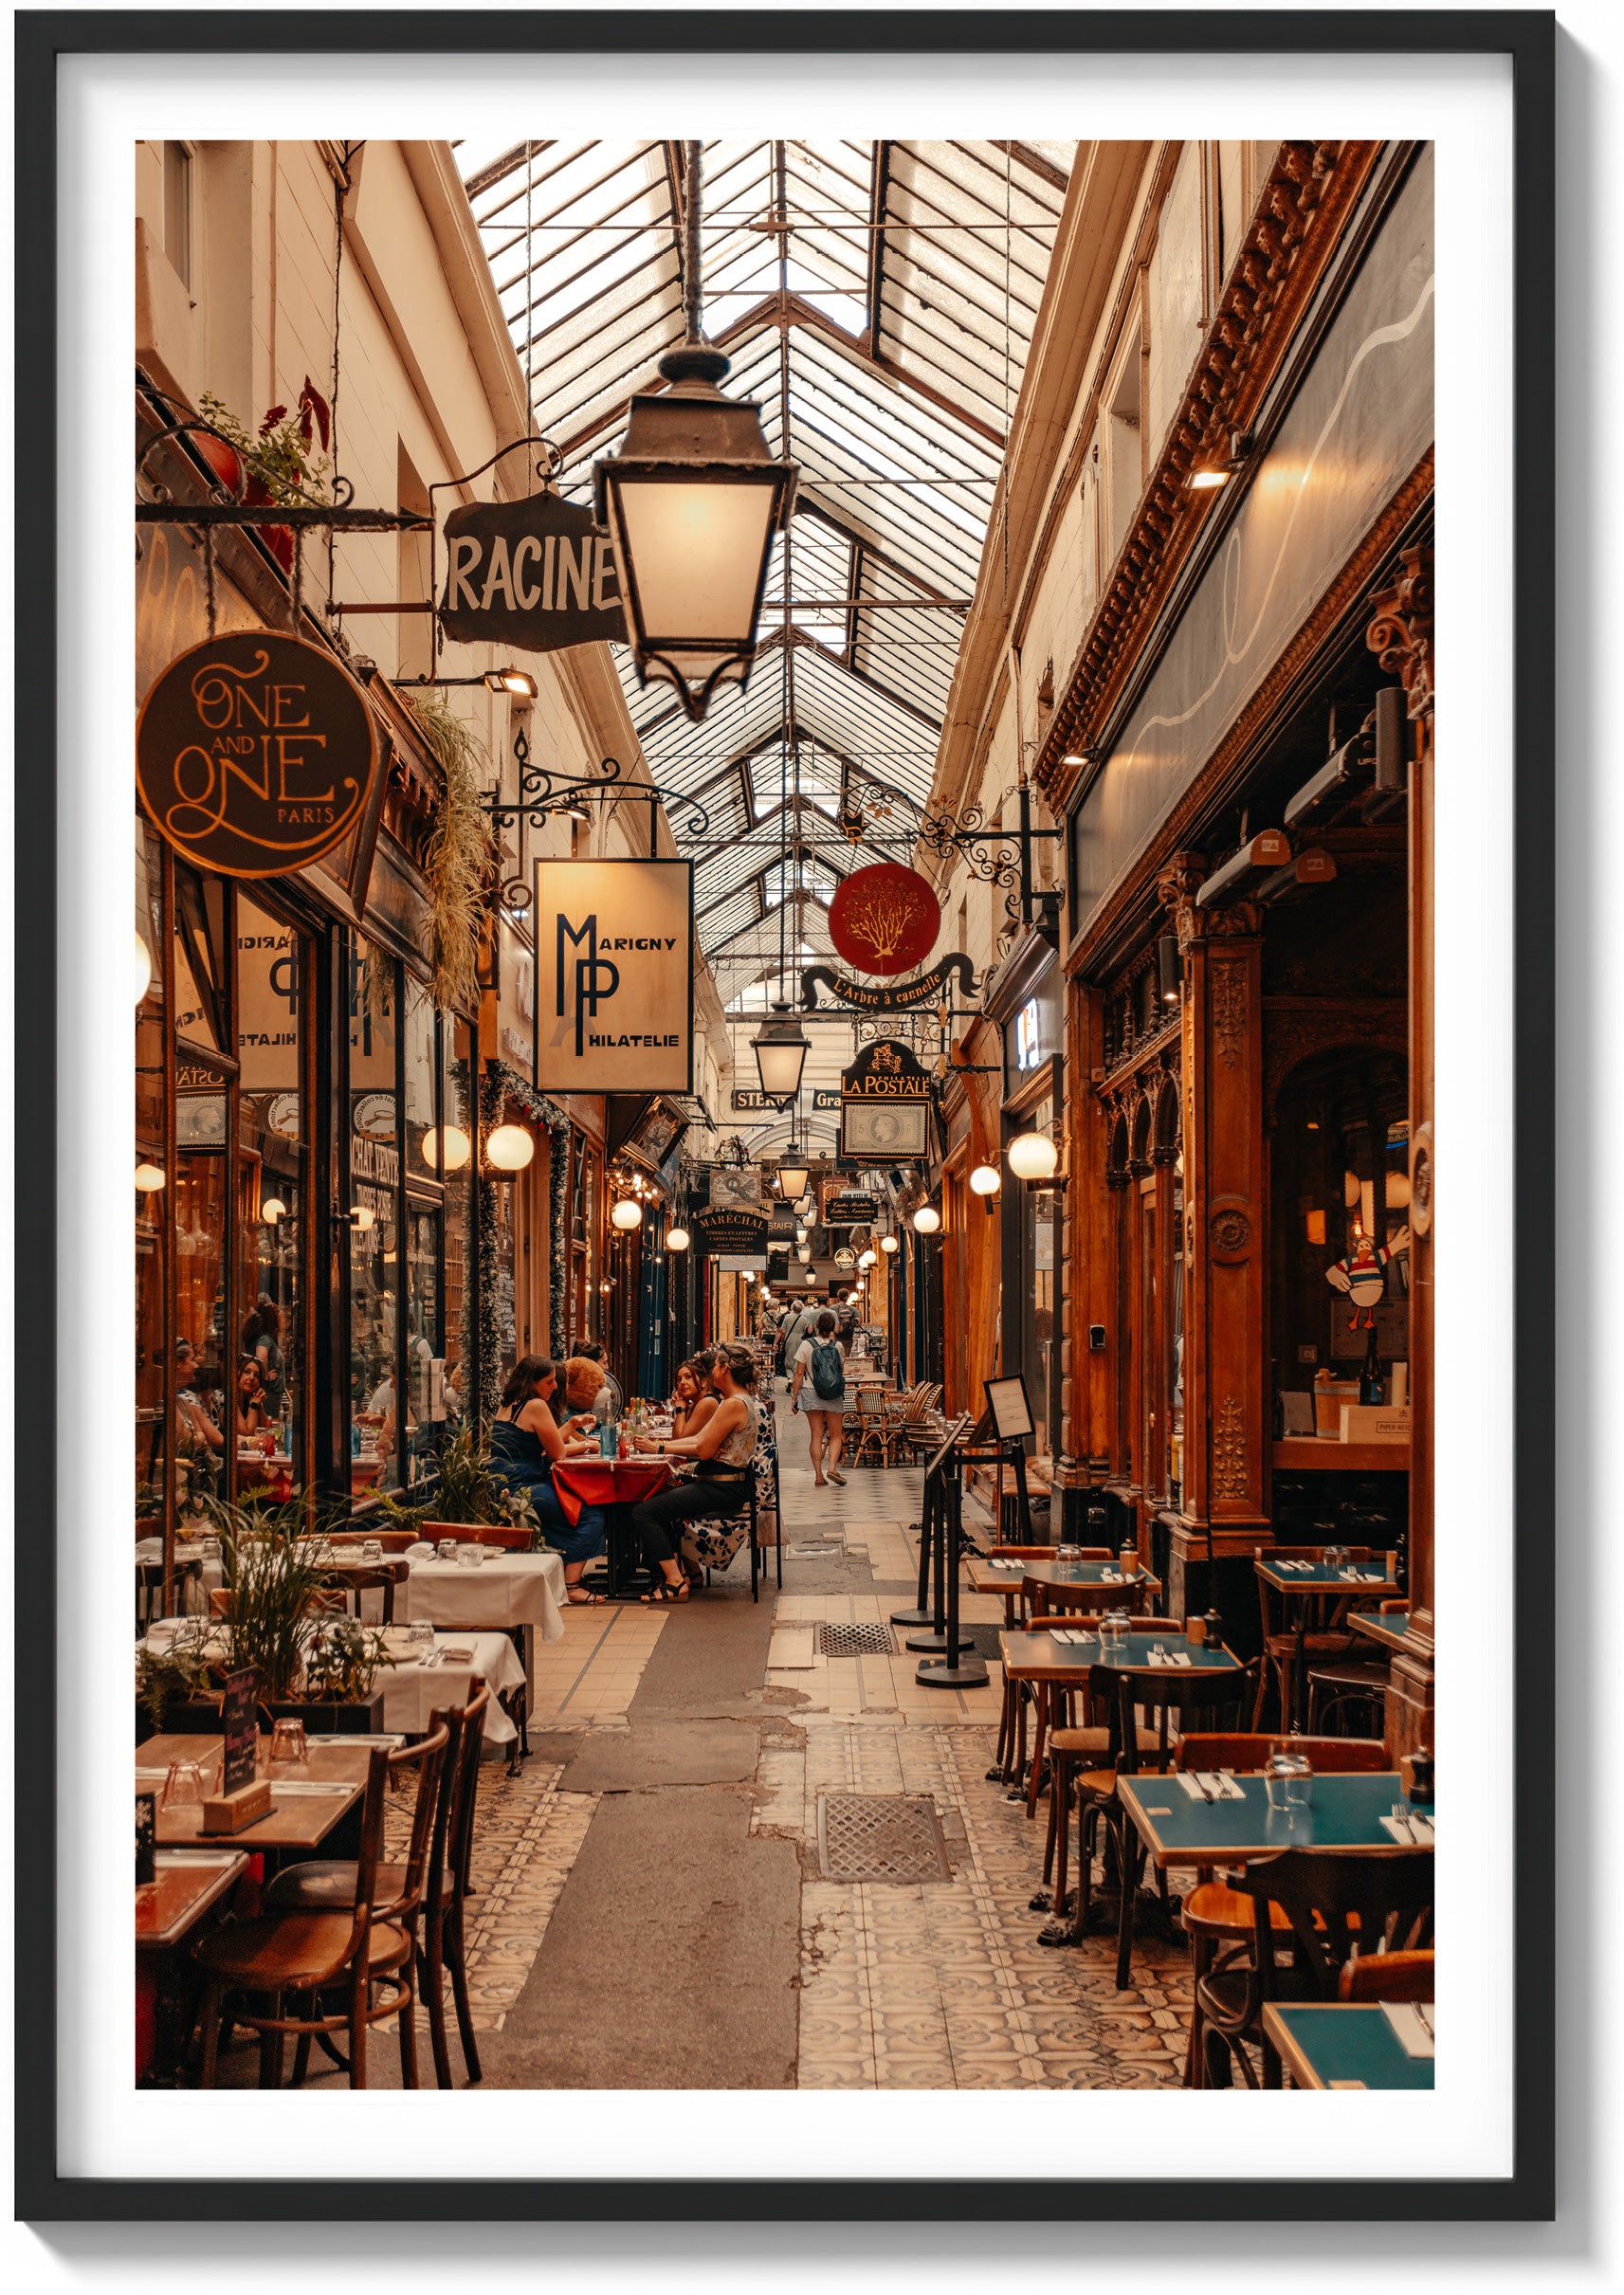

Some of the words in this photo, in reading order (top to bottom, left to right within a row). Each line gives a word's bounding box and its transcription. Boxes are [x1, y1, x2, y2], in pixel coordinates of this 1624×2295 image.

[192, 660, 311, 730] ONE
[210, 736, 255, 755] AND
[171, 735, 346, 815] ONE
[277, 807, 336, 825] PARIS
[833, 977, 879, 1005] L'Arbre
[884, 992, 892, 1005] à
[896, 973, 941, 1004] cannelle
[842, 1076, 862, 1094] LA
[865, 1076, 930, 1094] POSTALE
[700, 1212, 765, 1230] MARÉCHAL
